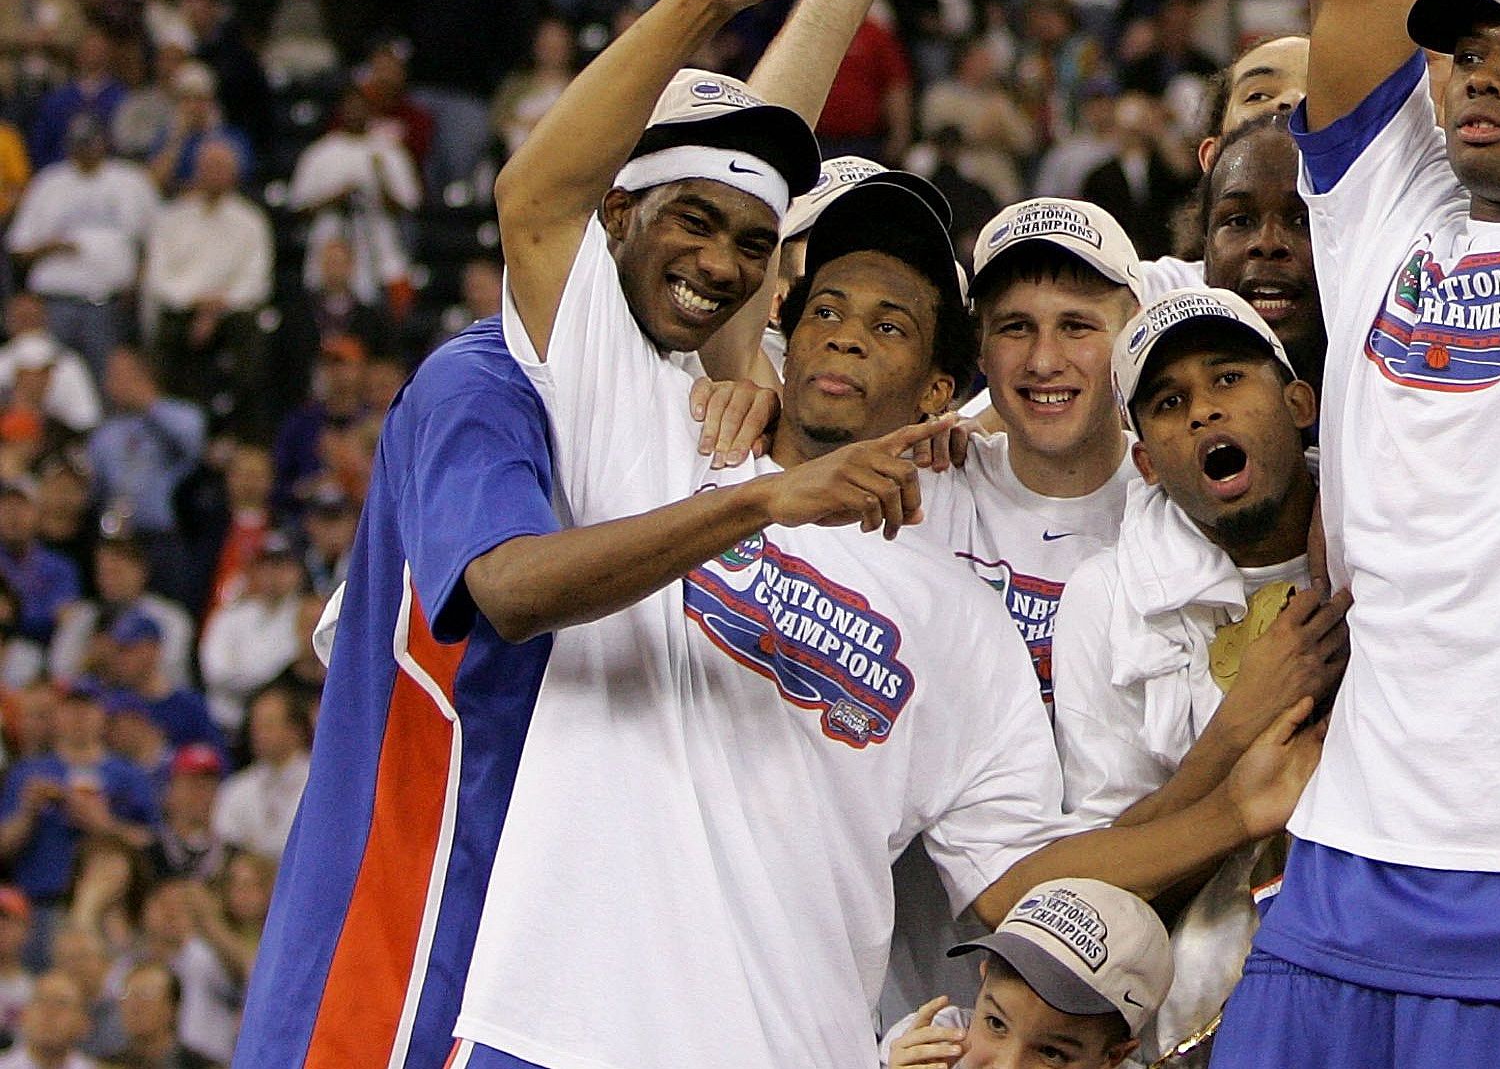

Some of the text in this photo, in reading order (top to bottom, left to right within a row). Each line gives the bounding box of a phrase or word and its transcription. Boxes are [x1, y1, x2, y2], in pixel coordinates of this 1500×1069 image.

[1013, 220, 1093, 239] CHAMPIONS
[1016, 210, 1081, 226] NATIONAL
[1149, 297, 1214, 322] NATIONAL
[762, 562, 885, 655] NATIONAL
[754, 582, 902, 699] CHAMPIONS
[1031, 908, 1102, 959] CHAMPIONS
[1044, 897, 1100, 937] NATIONAL
